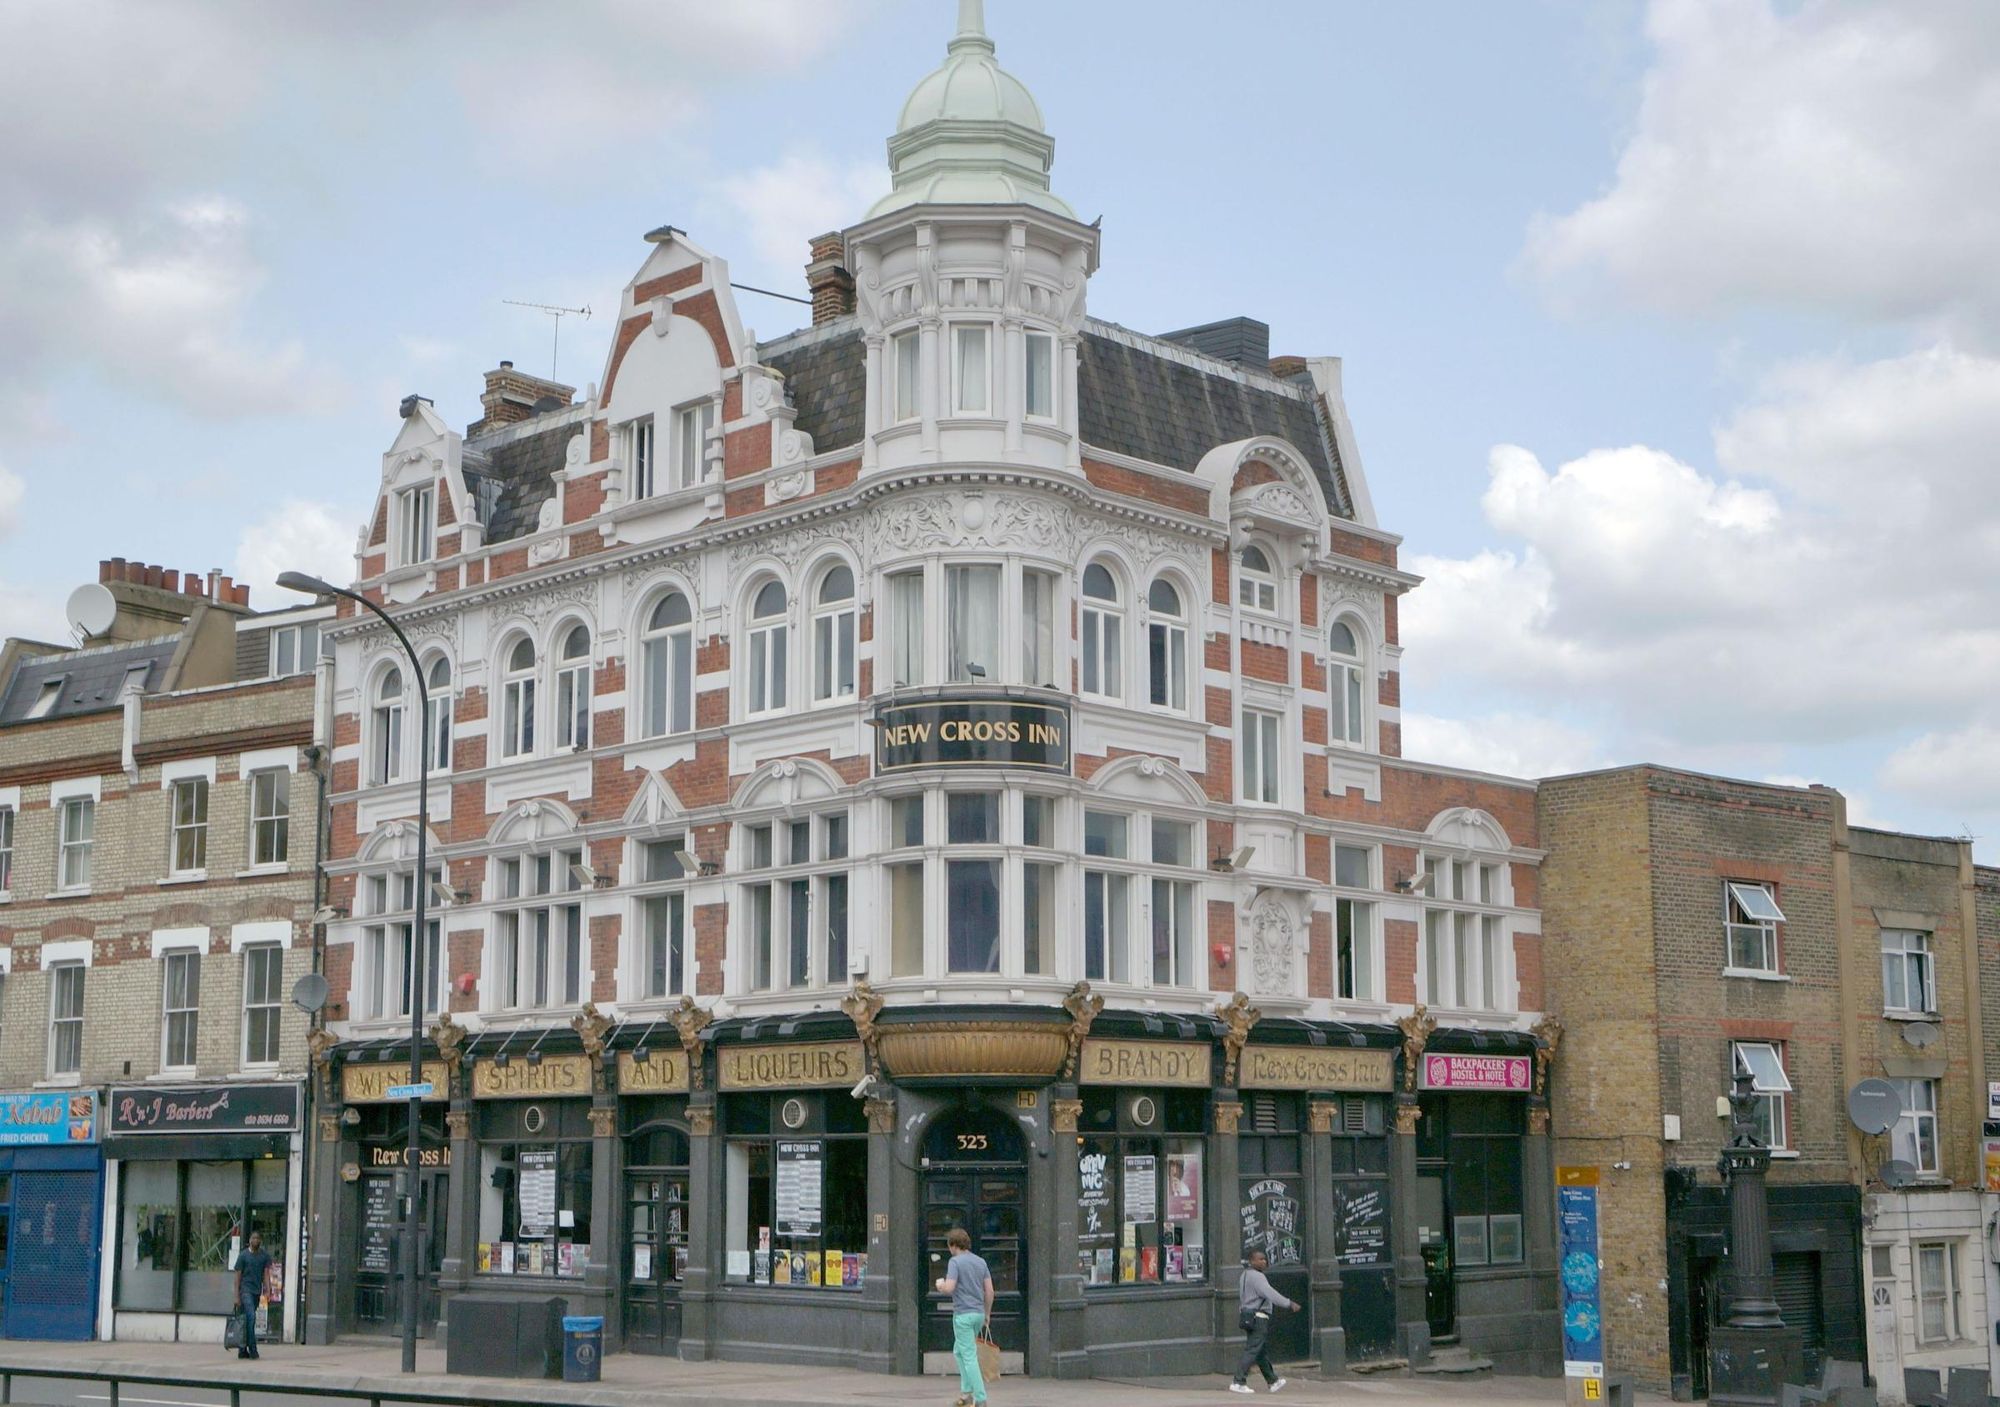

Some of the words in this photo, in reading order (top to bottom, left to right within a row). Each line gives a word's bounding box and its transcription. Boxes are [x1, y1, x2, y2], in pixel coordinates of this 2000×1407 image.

[885, 723, 931, 748] NEW
[940, 721, 1020, 743] CROSS
[1028, 723, 1061, 747] INN
[632, 1059, 674, 1084] AND
[736, 1051, 849, 1081] LIQUEURS
[1099, 1048, 1196, 1077] BRANDY
[1252, 1054, 1292, 1081] New
[1294, 1056, 1348, 1081] Cross
[1353, 1058, 1381, 1082] Inn
[1451, 1058, 1507, 1071] BACKPACKERS
[490, 1063, 576, 1090] SPIRITS
[1451, 1070, 1477, 1080] HOSTEL
[1478, 1070, 1485, 1081] &
[1486, 1071, 1507, 1081] HOTEL
[5, 1099, 62, 1125] Kebab
[166, 1101, 213, 1120] Barbers
[20, 1133, 49, 1143] CHICKEN
[957, 1135, 988, 1150] 323
[373, 1147, 399, 1165] New
[1249, 1182, 1265, 1200] NEW
[1265, 1181, 1272, 1191] X
[1586, 1381, 1600, 1397] H
